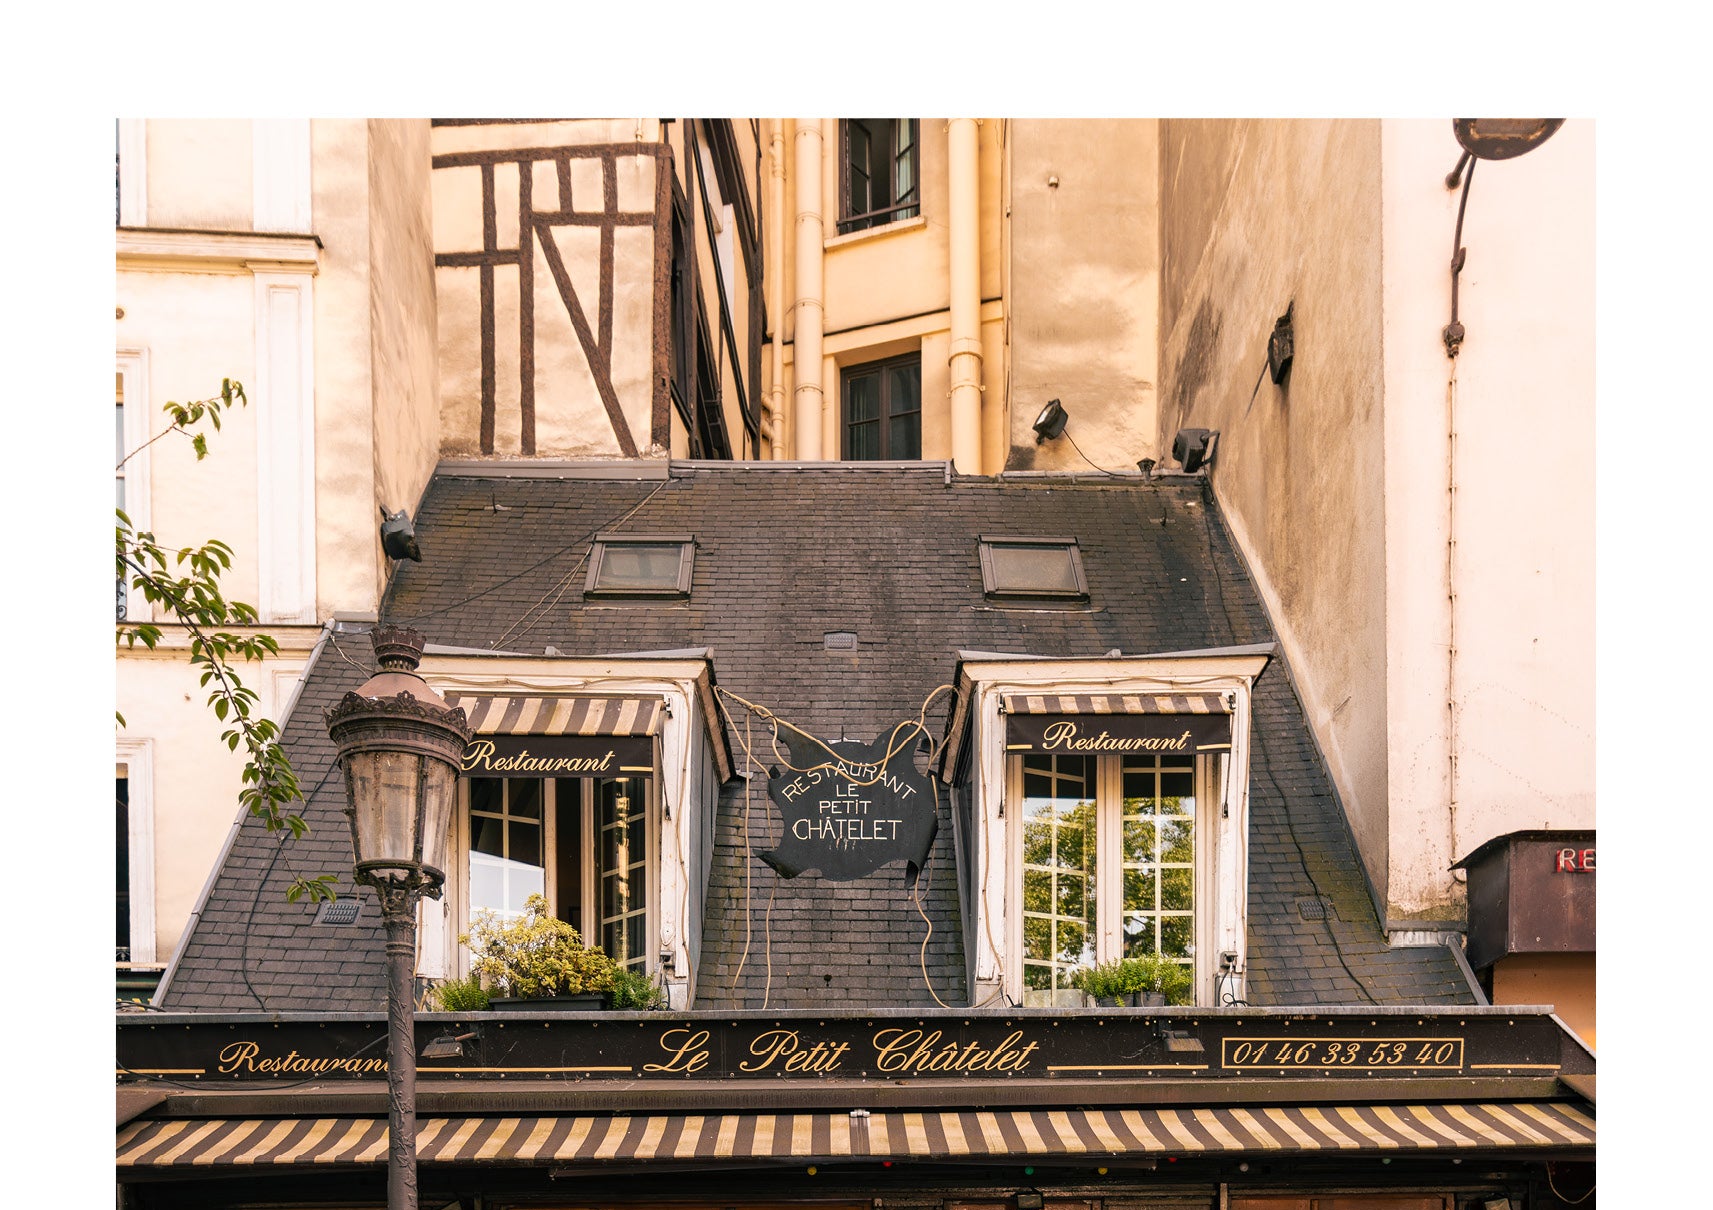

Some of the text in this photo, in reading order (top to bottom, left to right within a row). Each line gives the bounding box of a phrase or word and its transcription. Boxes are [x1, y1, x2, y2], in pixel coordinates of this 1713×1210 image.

[1042, 721, 1192, 750] Restaurant
[461, 740, 616, 772] Restaurant
[782, 760, 917, 802] RESTAURANT
[836, 784, 860, 797] LE
[792, 816, 902, 840] CHÂTELET
[217, 1041, 389, 1074] Restauran
[643, 1028, 1040, 1073] Le Petit Châtelet
[1233, 1042, 1454, 1065] 01 46 33 53 40
